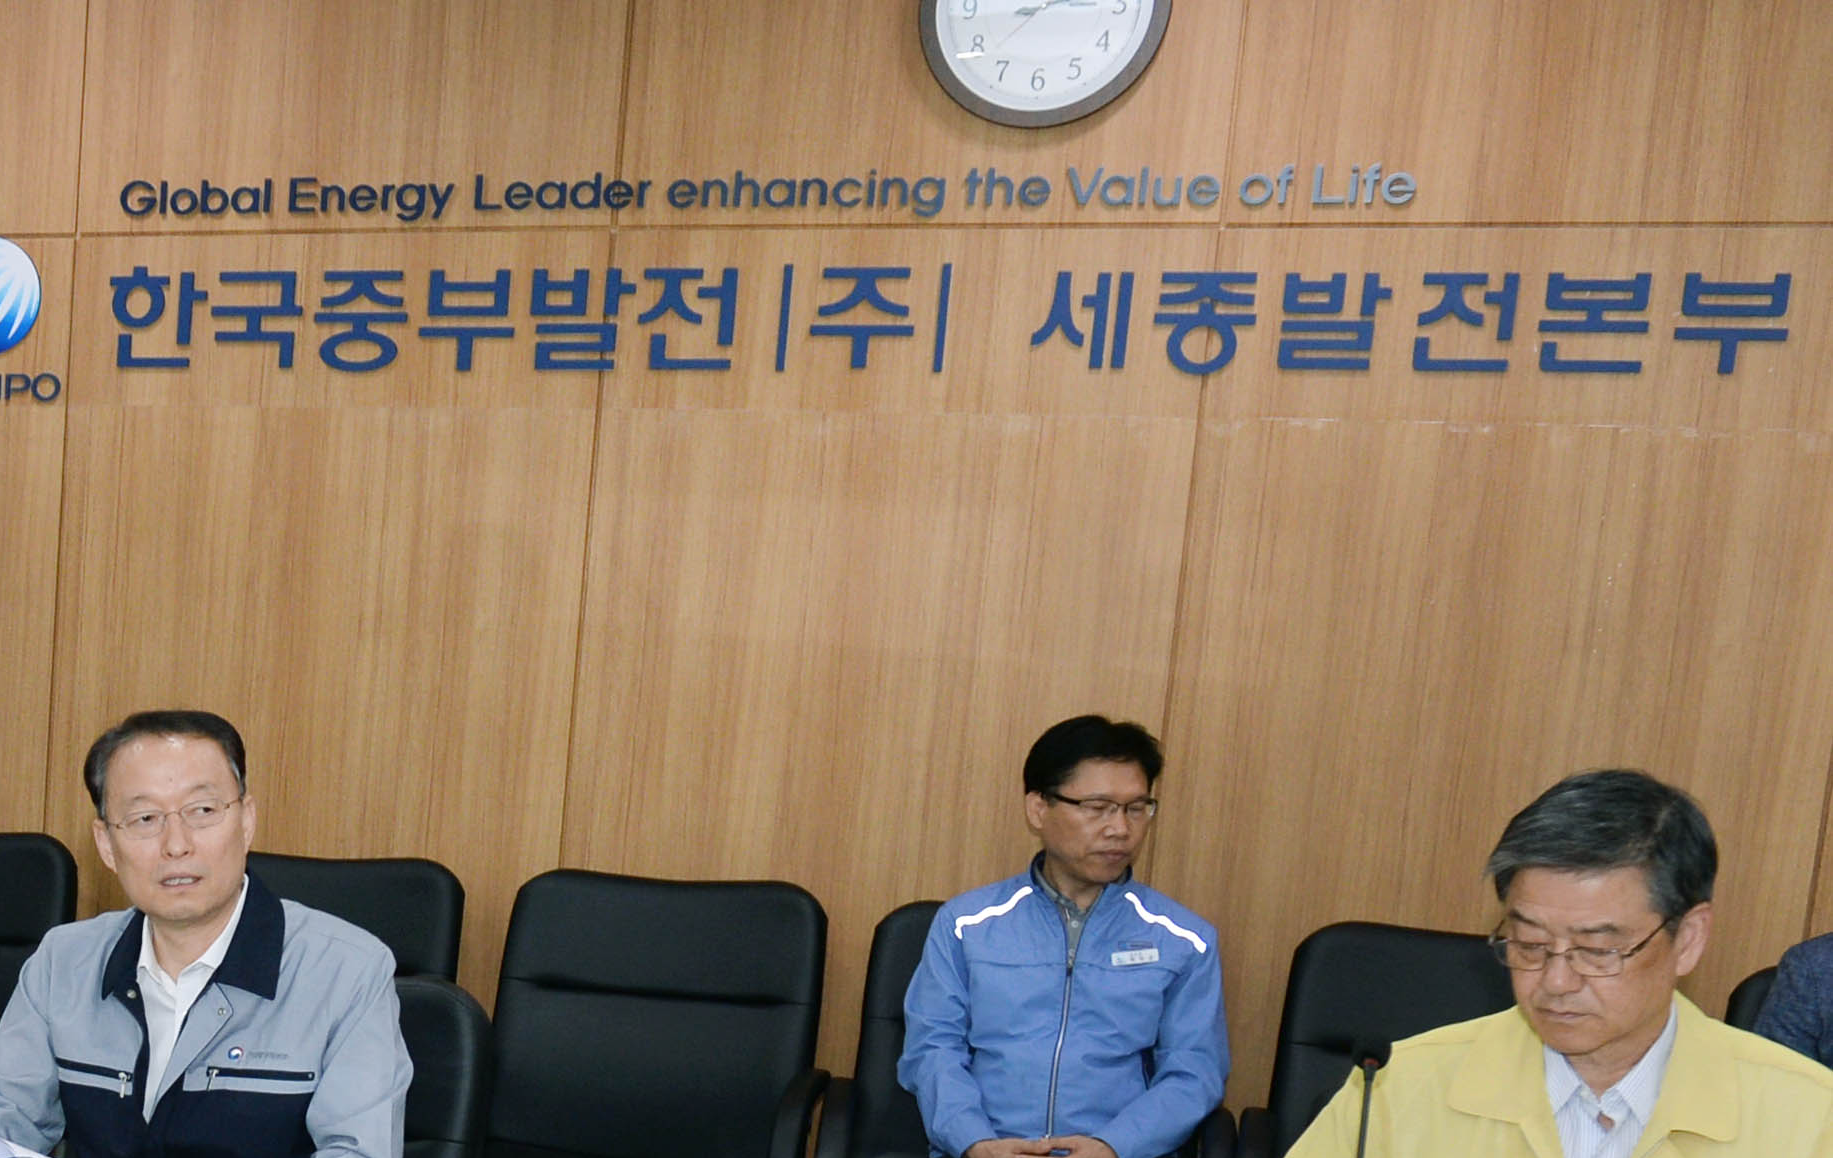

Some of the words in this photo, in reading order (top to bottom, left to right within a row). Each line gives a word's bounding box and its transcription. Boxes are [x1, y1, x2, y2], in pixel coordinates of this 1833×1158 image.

[1096, 30, 1110, 52] 4
[995, 60, 1010, 82] 7
[1031, 68, 1045, 91] 6
[1067, 57, 1082, 80] 5
[120, 179, 272, 218] Global
[288, 177, 454, 223] Energy
[474, 174, 652, 213] Leader
[667, 170, 946, 217] enhancing
[965, 167, 1052, 208] the
[1067, 166, 1221, 208] Value
[1238, 163, 1297, 206] of
[1311, 162, 1418, 205] Life
[1030, 271, 1793, 375] 세종발전본부
